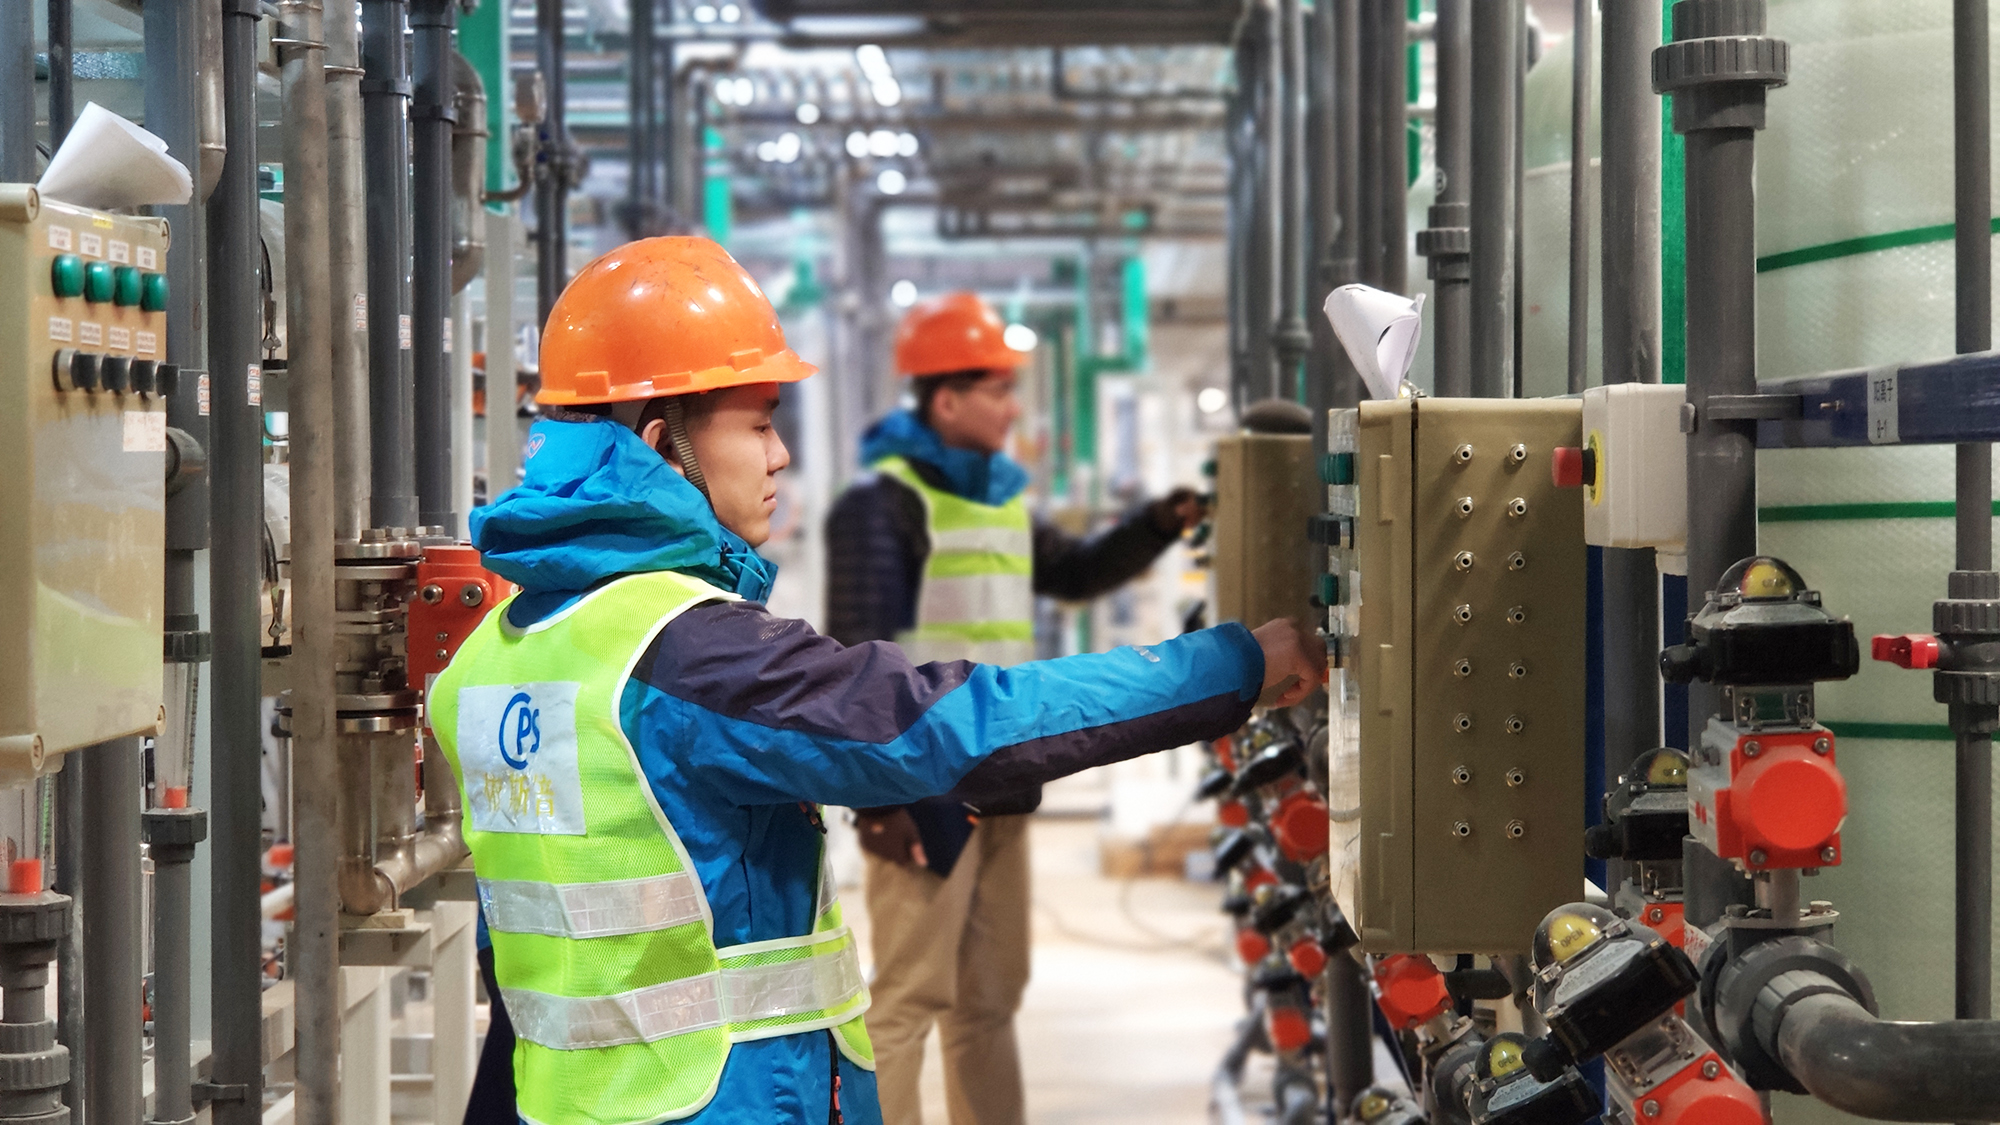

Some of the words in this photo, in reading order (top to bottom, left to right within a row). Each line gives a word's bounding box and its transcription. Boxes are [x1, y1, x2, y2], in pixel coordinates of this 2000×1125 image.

[499, 692, 540, 770] CPS
[1560, 928, 1585, 948] OPEN
[1497, 1054, 1518, 1069] OPEN
